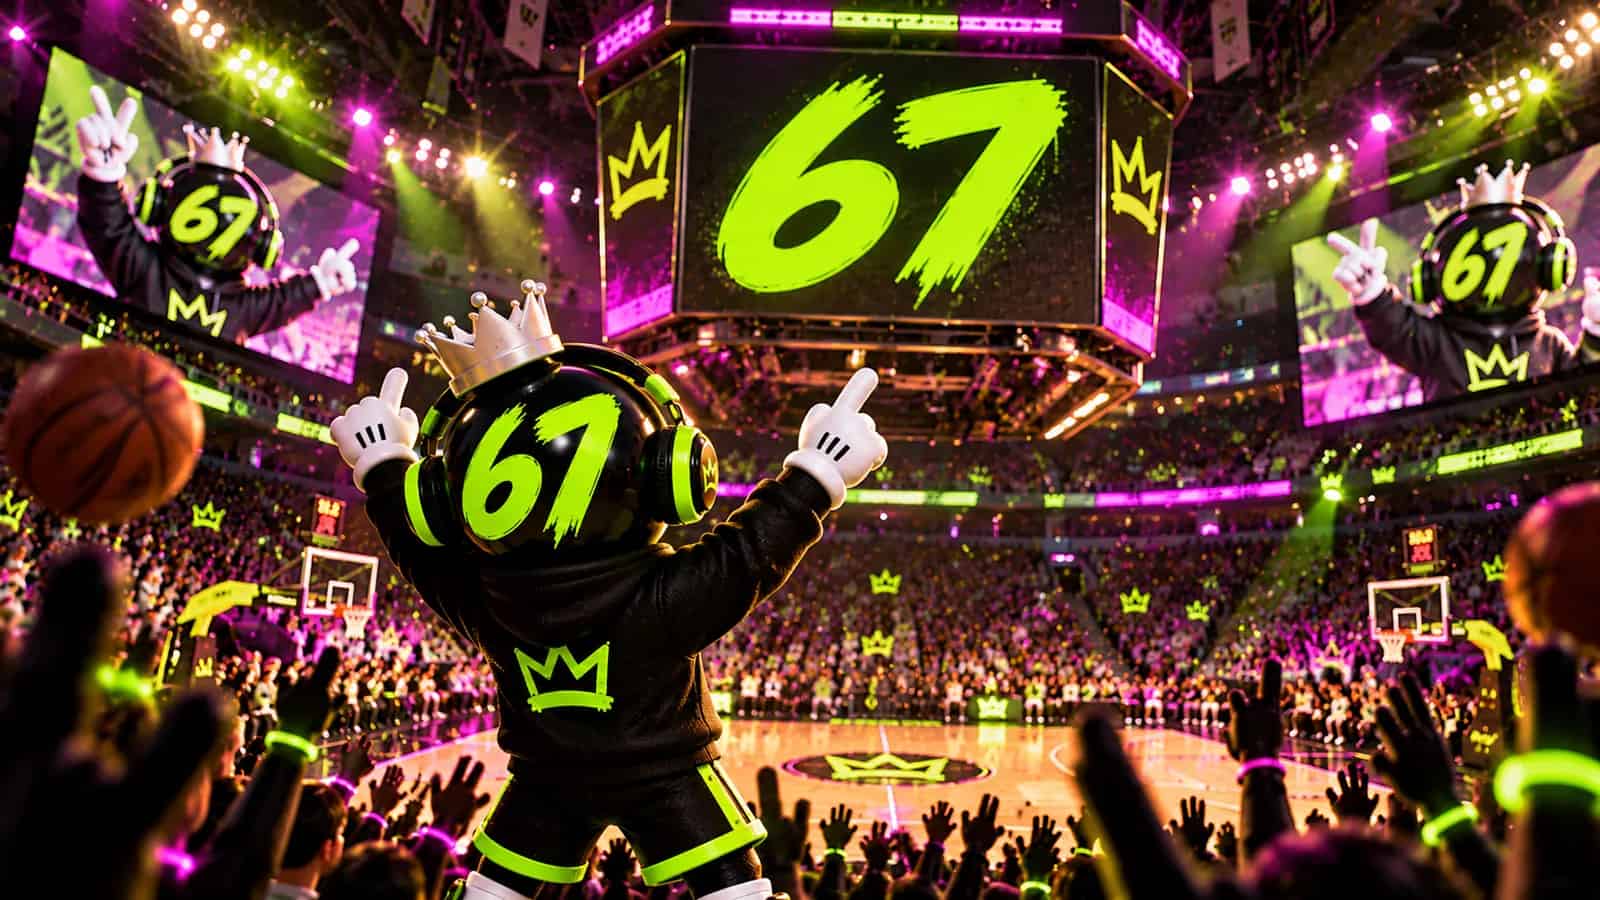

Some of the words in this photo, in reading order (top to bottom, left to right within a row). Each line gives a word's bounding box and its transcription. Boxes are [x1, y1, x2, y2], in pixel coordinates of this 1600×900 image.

[169, 185, 257, 261] 67
[716, 73, 1068, 309] 67
[1441, 222, 1528, 306] 67
[462, 393, 621, 548] 67
